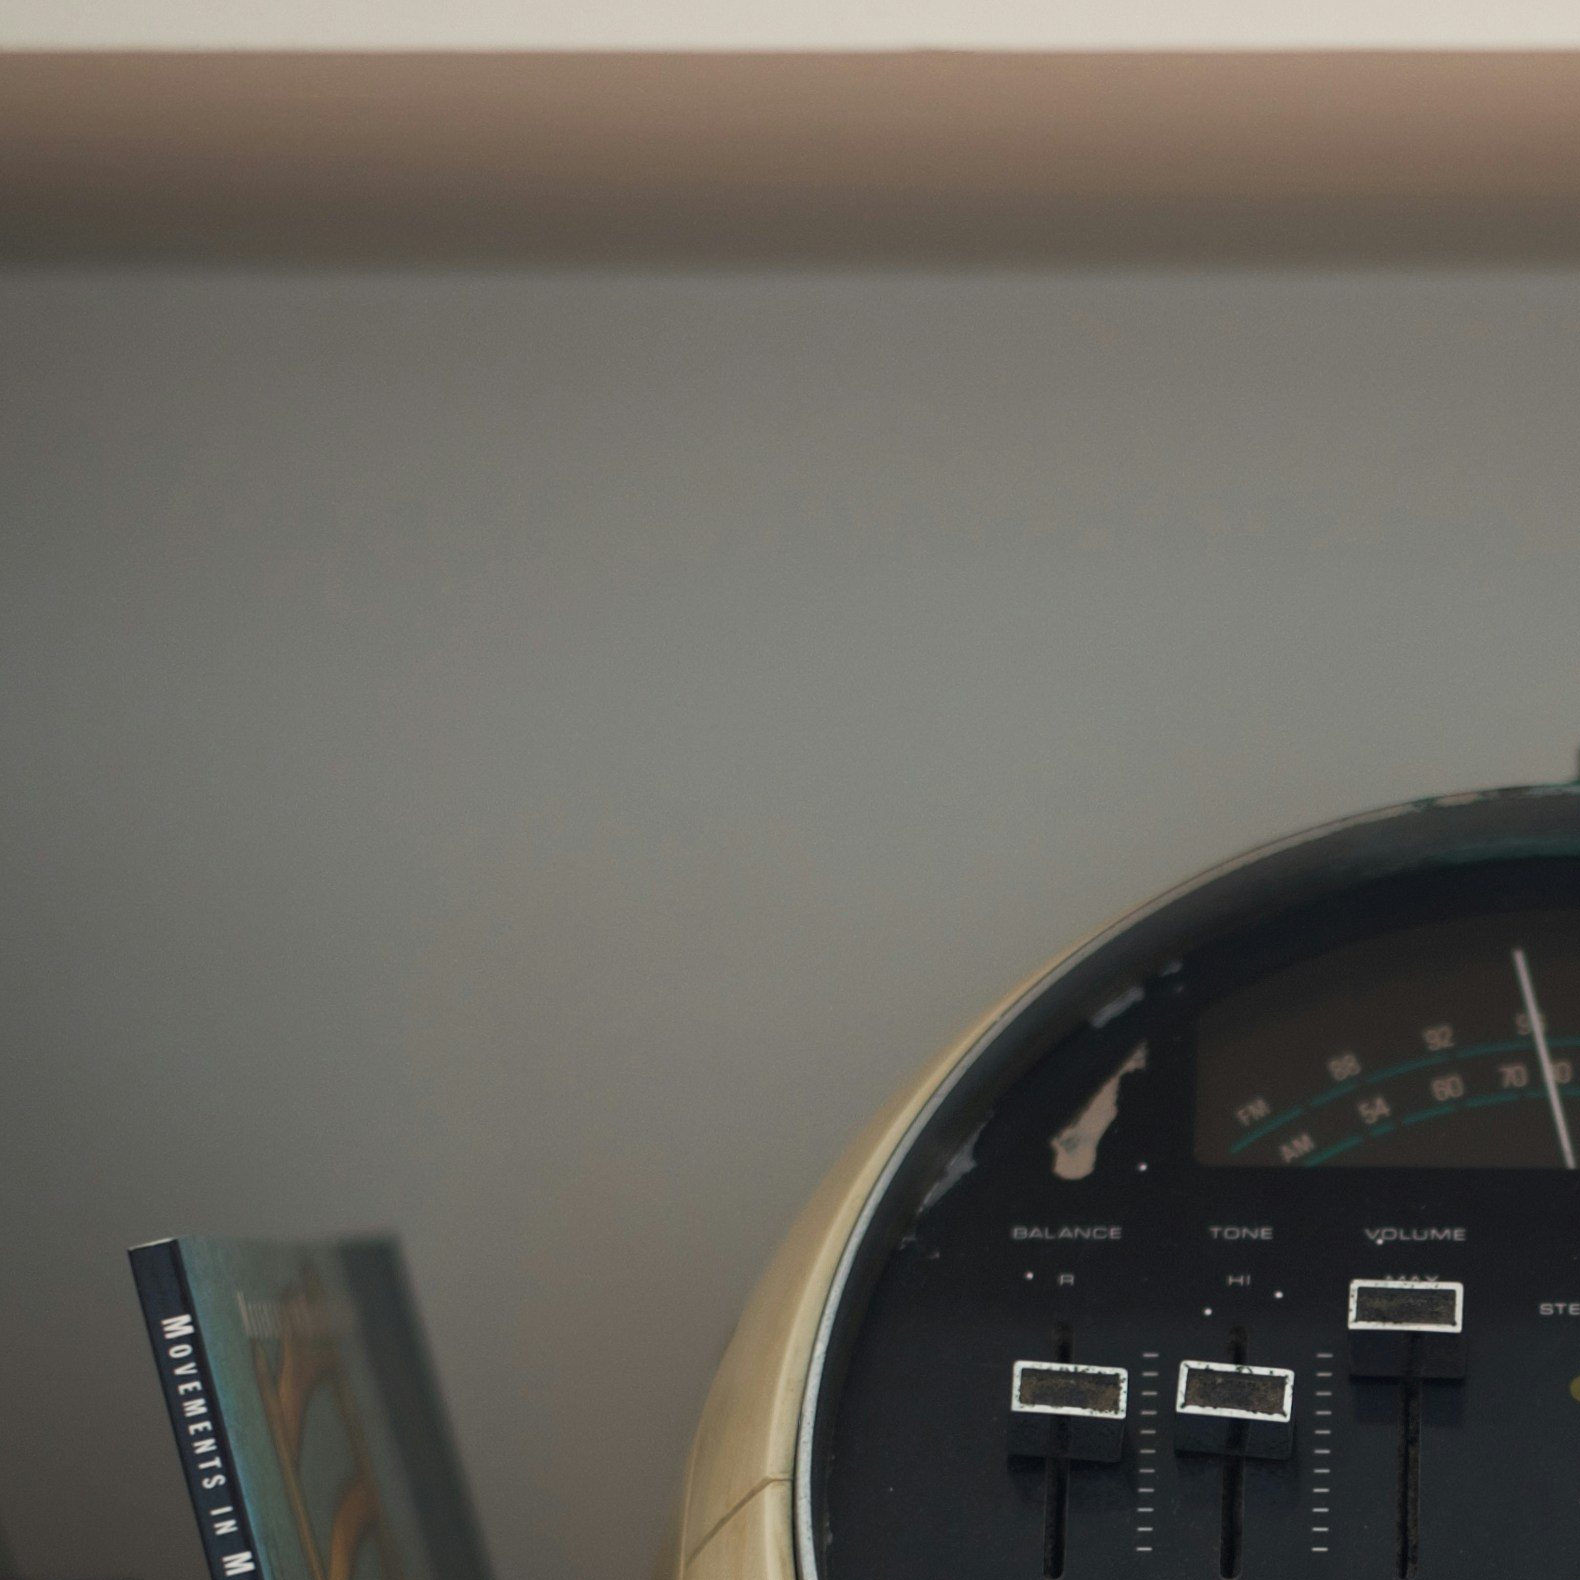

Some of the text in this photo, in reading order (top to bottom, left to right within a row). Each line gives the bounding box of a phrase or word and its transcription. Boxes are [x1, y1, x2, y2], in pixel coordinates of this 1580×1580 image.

[1280, 1132, 1315, 1163] AM
[1499, 1063, 1529, 1088] 70
[1011, 1226, 1122, 1240] BALANCE
[1209, 1226, 1274, 1240] TONE
[1365, 1227, 1467, 1242] VOLUME
[1057, 1274, 1075, 1286] R
[1227, 1274, 1251, 1286] HI
[161, 1313, 226, 1490] MOVEMENTS
[210, 1506, 238, 1535] IN
